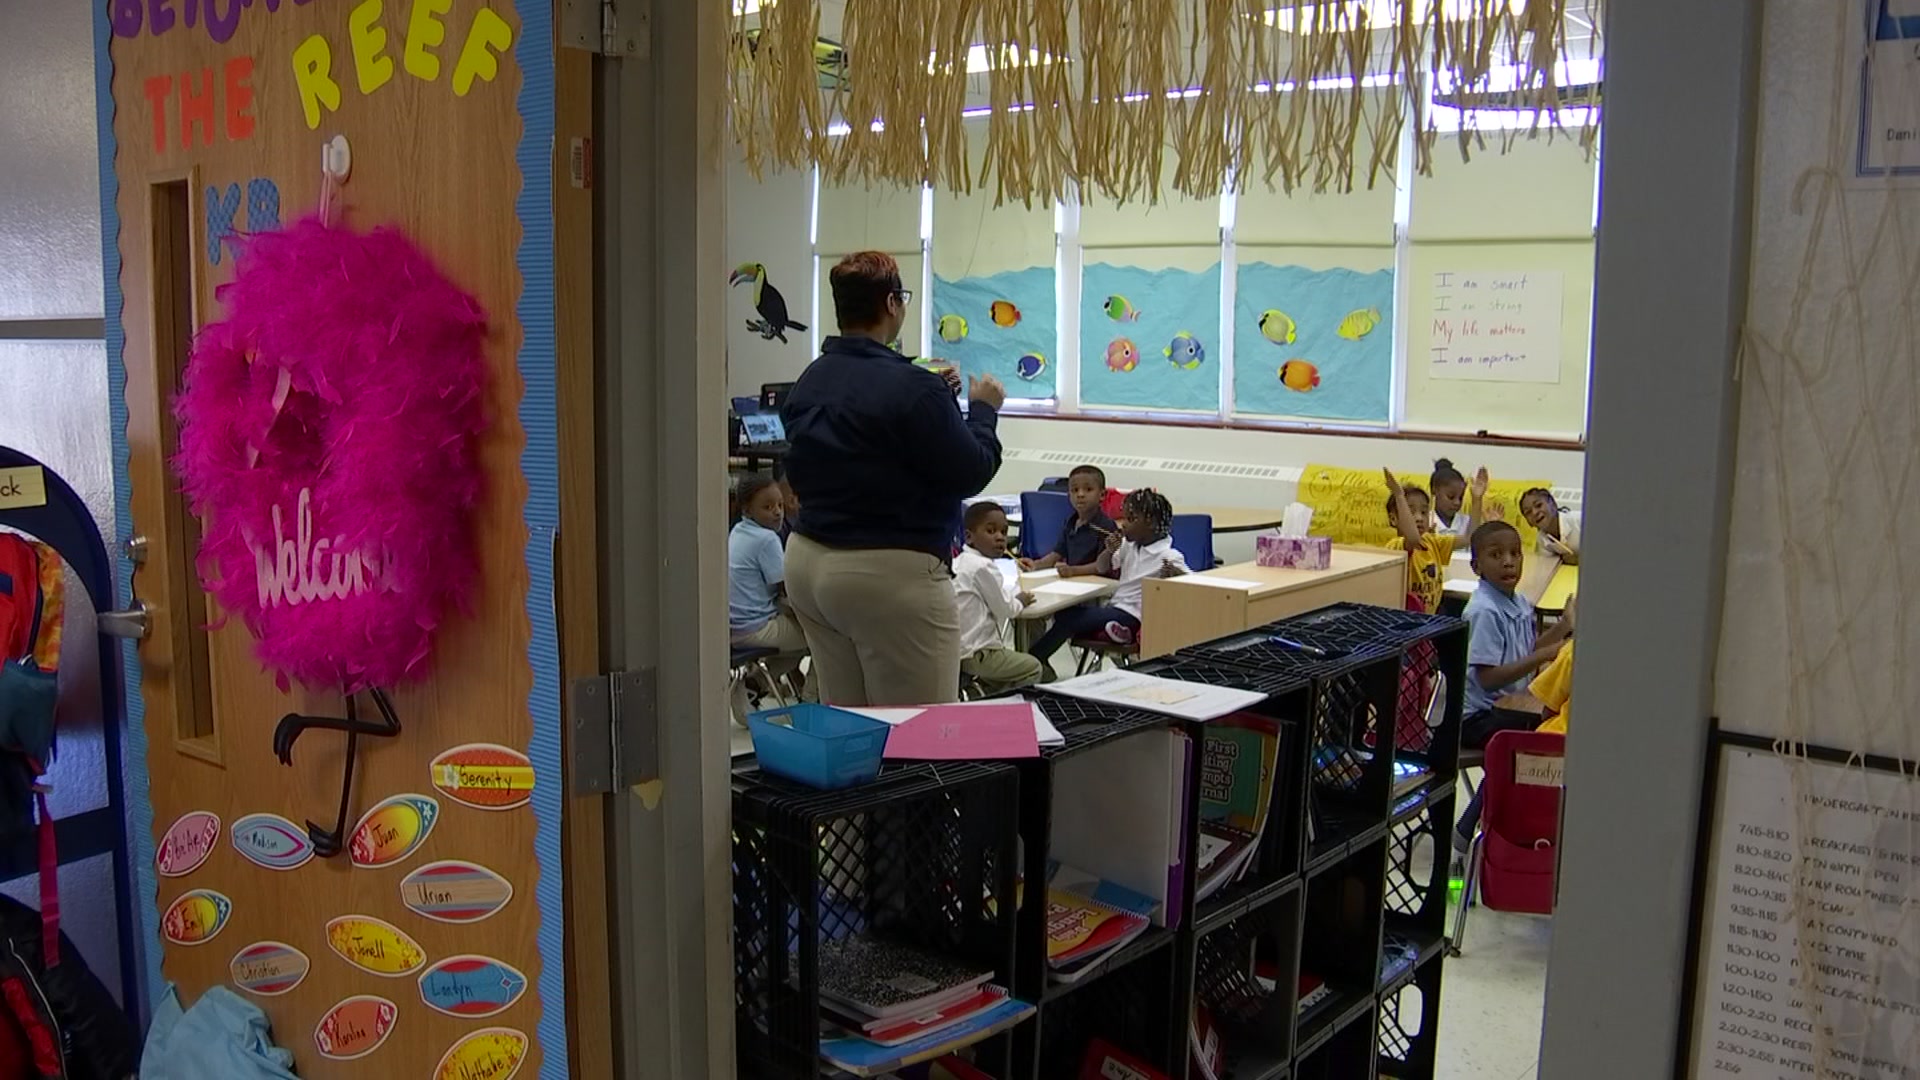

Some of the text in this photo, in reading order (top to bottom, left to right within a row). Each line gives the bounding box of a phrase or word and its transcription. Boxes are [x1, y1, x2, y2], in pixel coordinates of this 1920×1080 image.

[292, 0, 513, 131] REEF
[144, 55, 256, 154] THE
[1433, 272, 1528, 290] I am smart
[1432, 295, 1523, 317] I am strong
[1432, 318, 1527, 345] My life matters
[1430, 347, 1450, 364] I
[1456, 356, 1473, 365] am
[1205, 739, 1237, 757] First
[459, 764, 513, 797] Serenity
[373, 823, 400, 849] Juan
[1783, 1017, 1834, 1037] RECES
